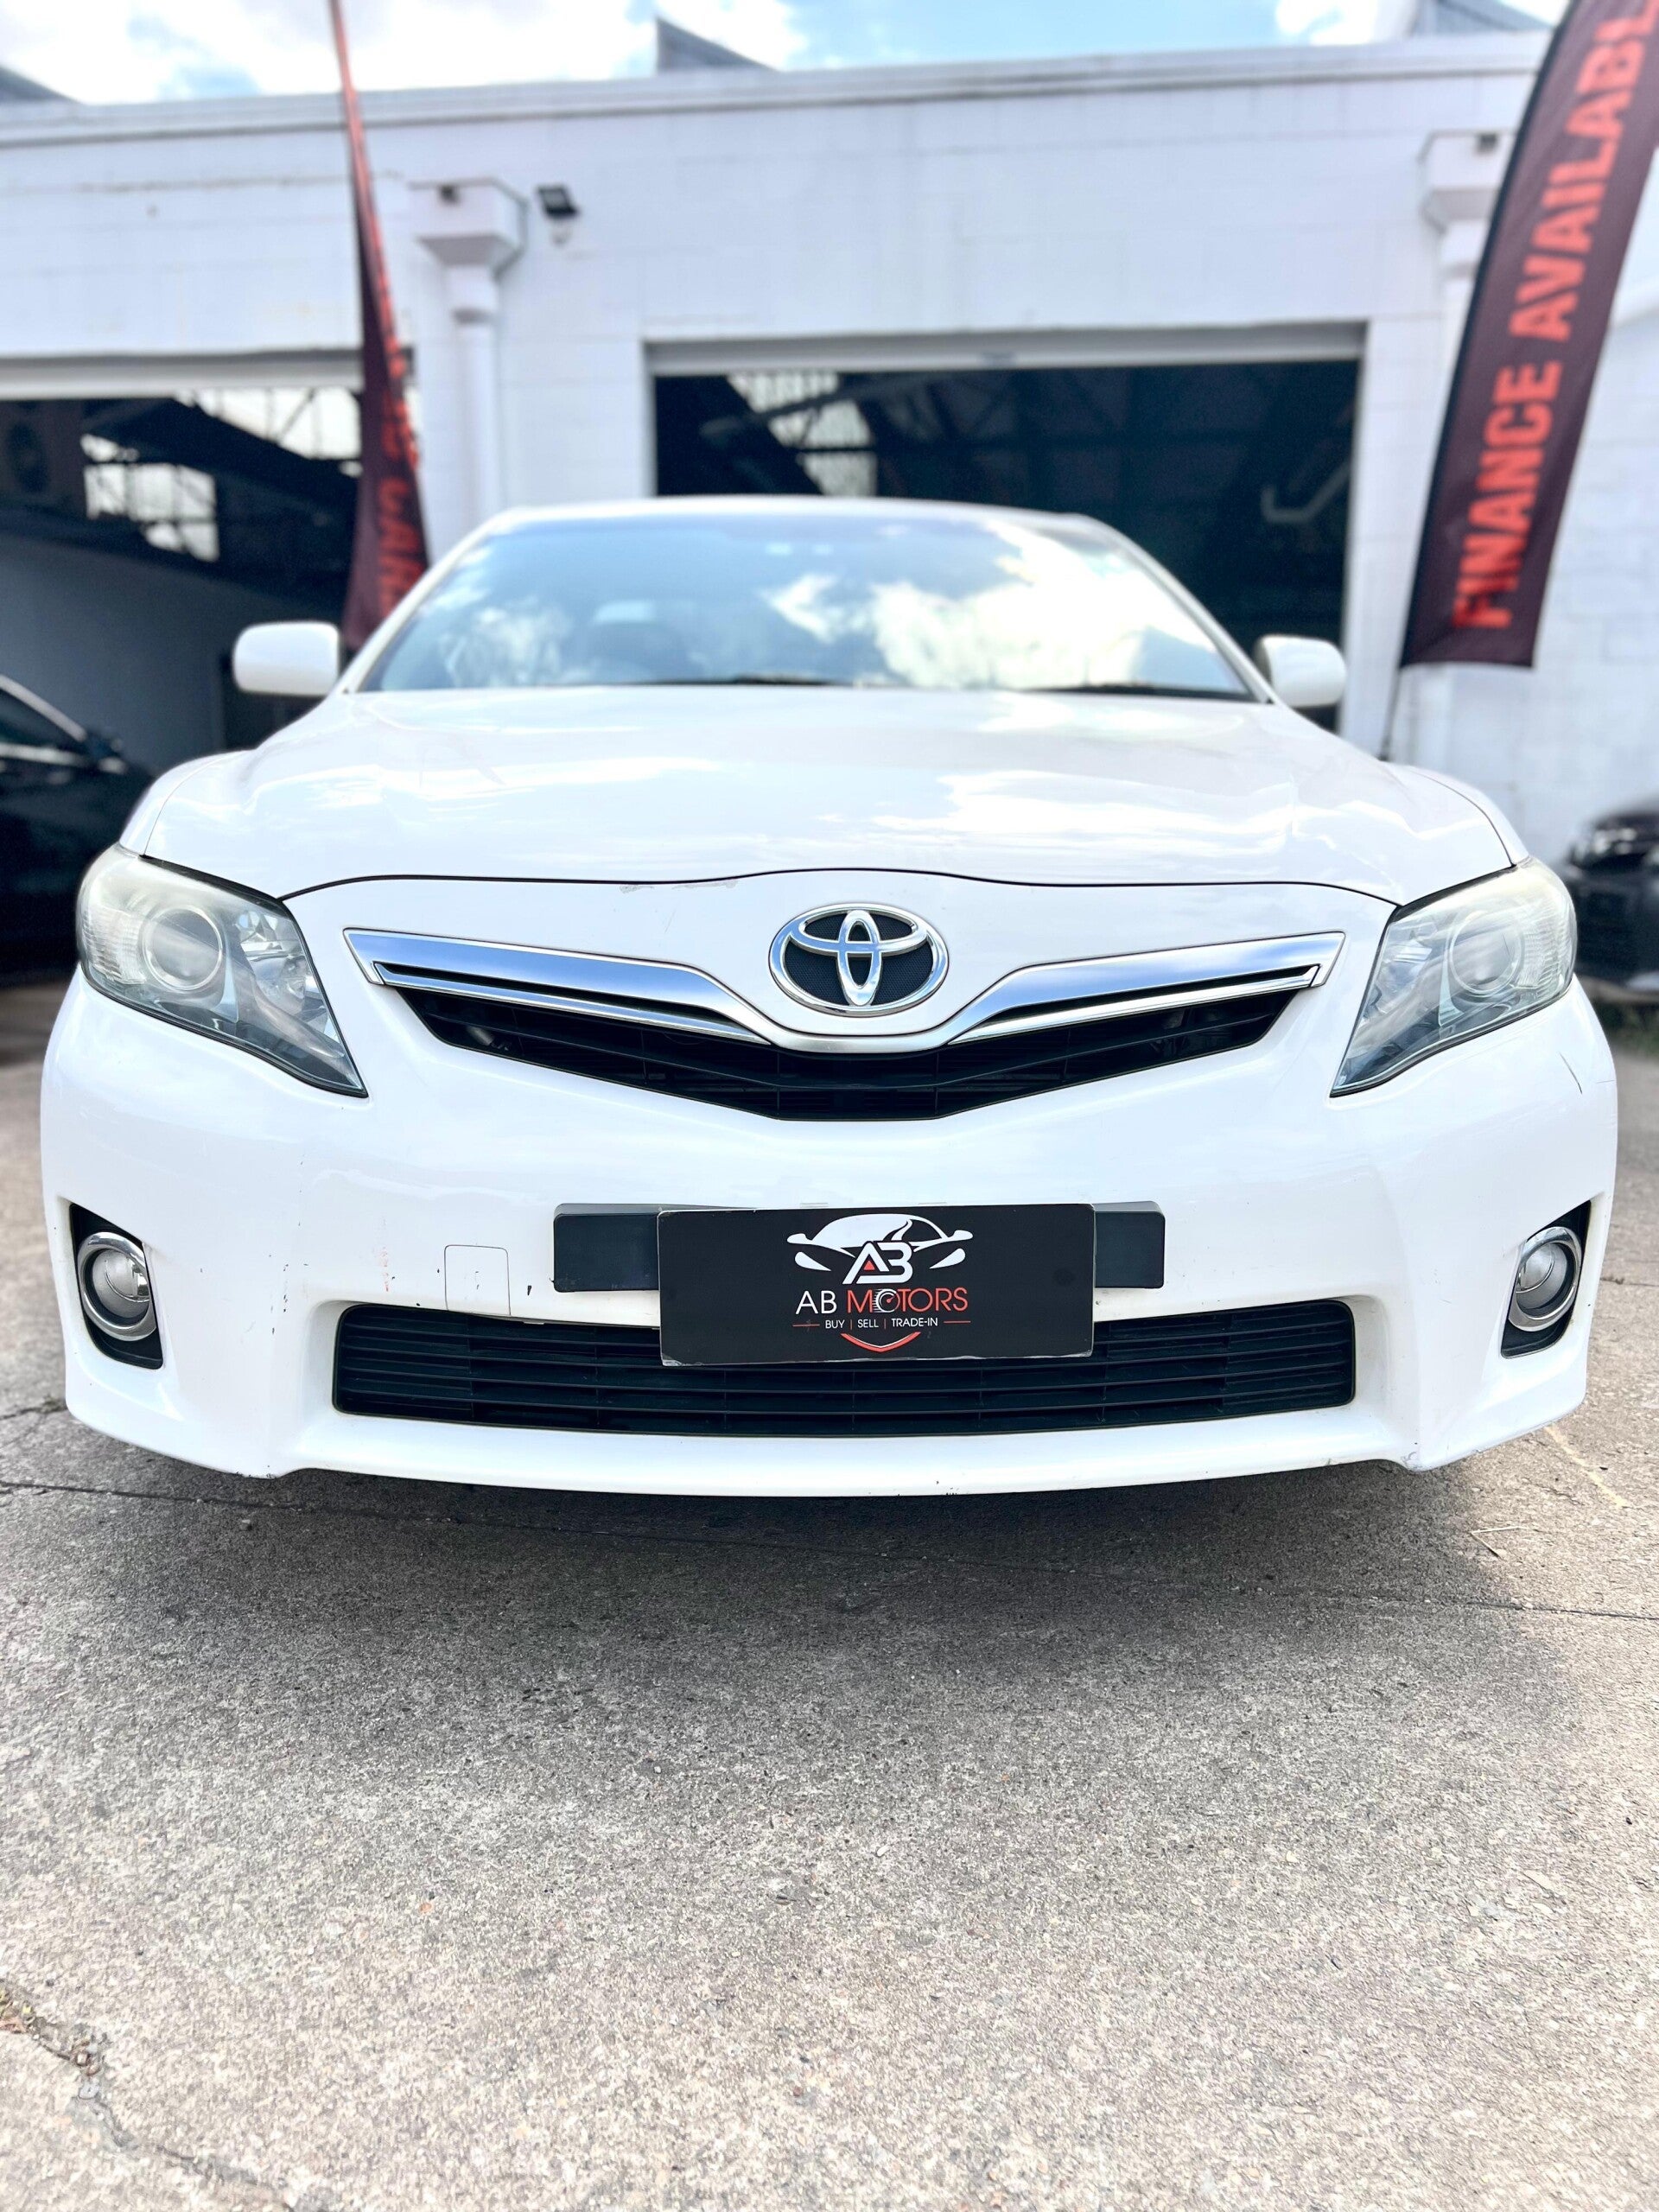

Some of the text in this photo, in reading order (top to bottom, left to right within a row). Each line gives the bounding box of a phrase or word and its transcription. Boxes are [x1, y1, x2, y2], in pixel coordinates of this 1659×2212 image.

[1452, 360, 1562, 629] FINANCE
[842, 1242, 913, 1285] AB
[795, 1287, 969, 1314] AB MOTORS
[825, 1317, 938, 1329] BUY SELL TRADE-IN
